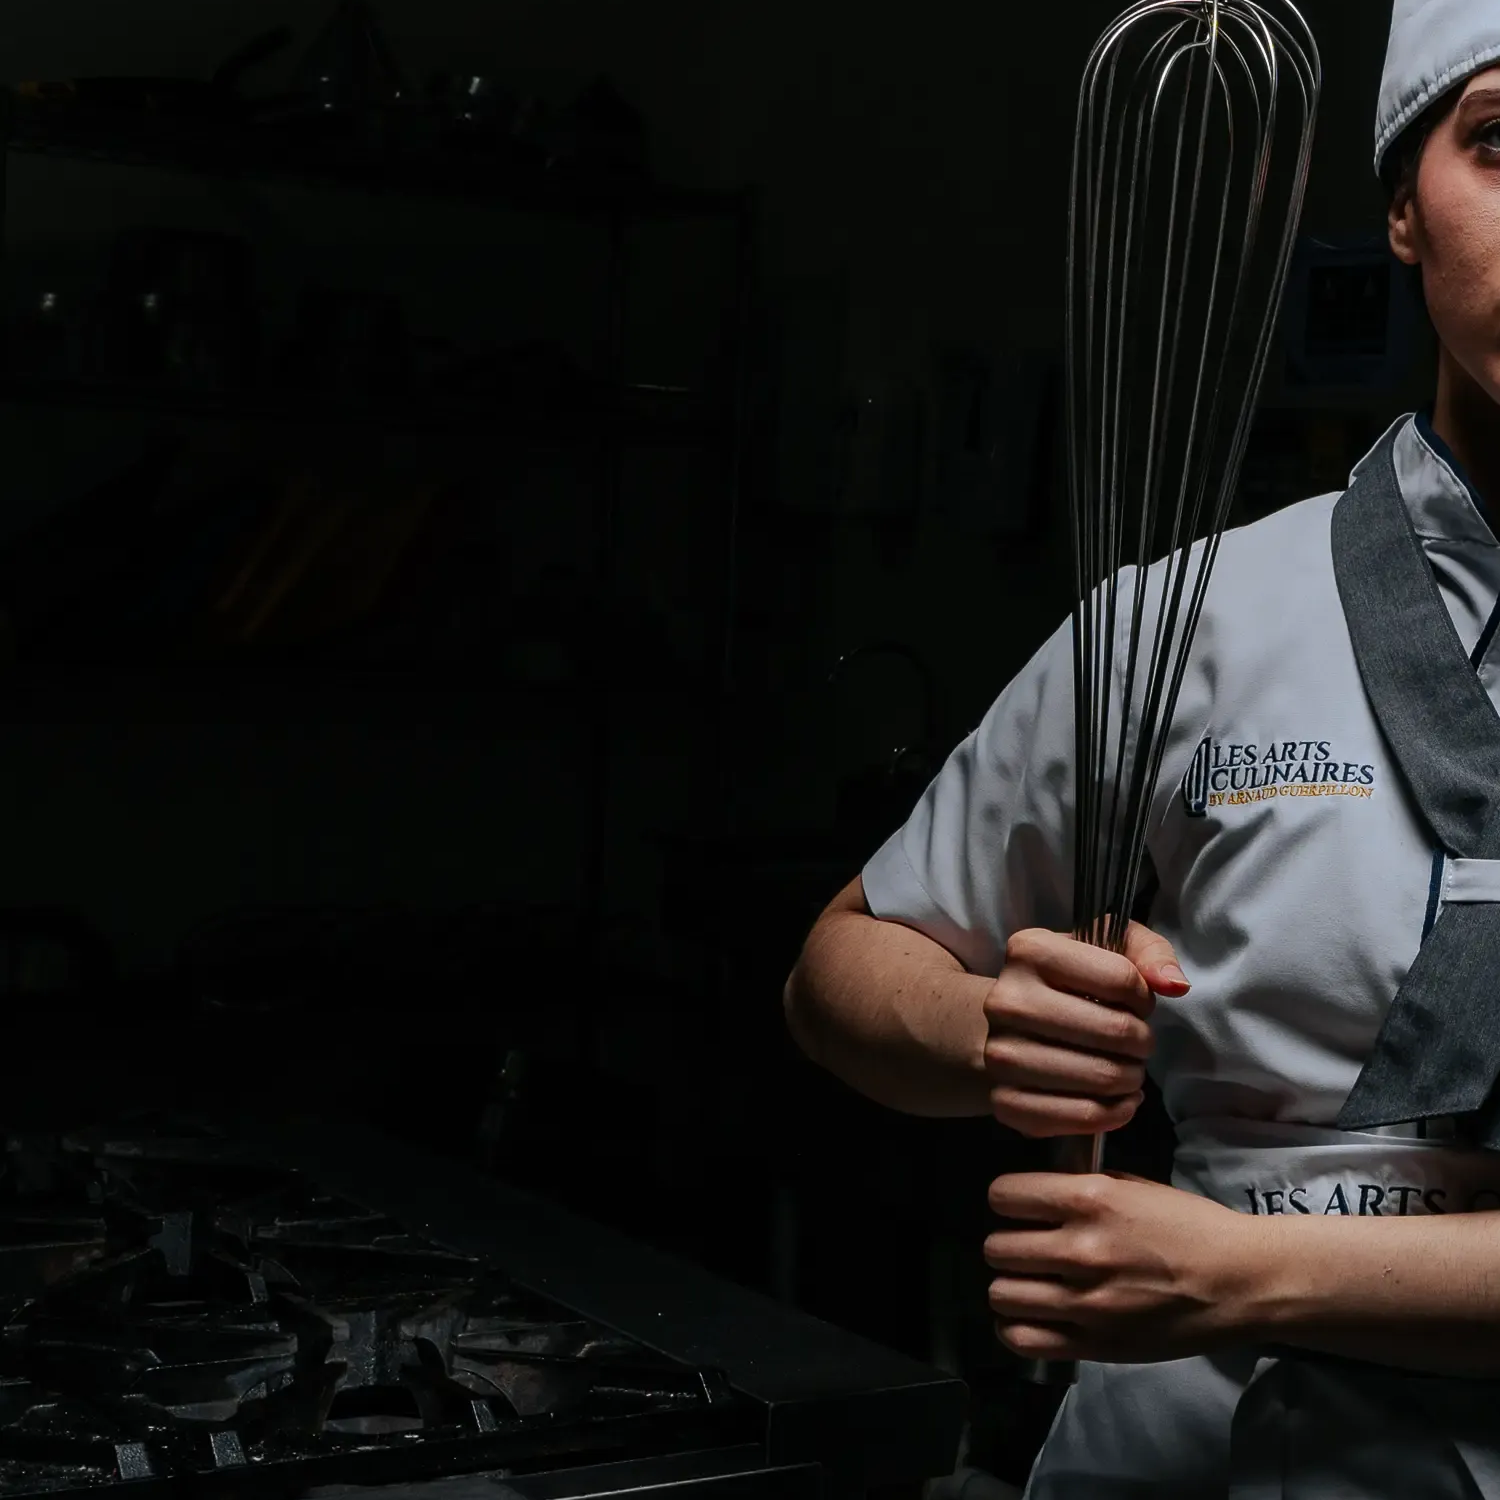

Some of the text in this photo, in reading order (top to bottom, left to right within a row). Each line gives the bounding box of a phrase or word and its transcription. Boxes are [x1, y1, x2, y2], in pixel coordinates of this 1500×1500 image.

[1211, 741, 1331, 768] LES ARTS
[1210, 762, 1375, 791] CULINAIRES
[1209, 792, 1225, 806] BY
[1227, 785, 1277, 805] ARNAUD
[1323, 1183, 1448, 1216] ARTS
